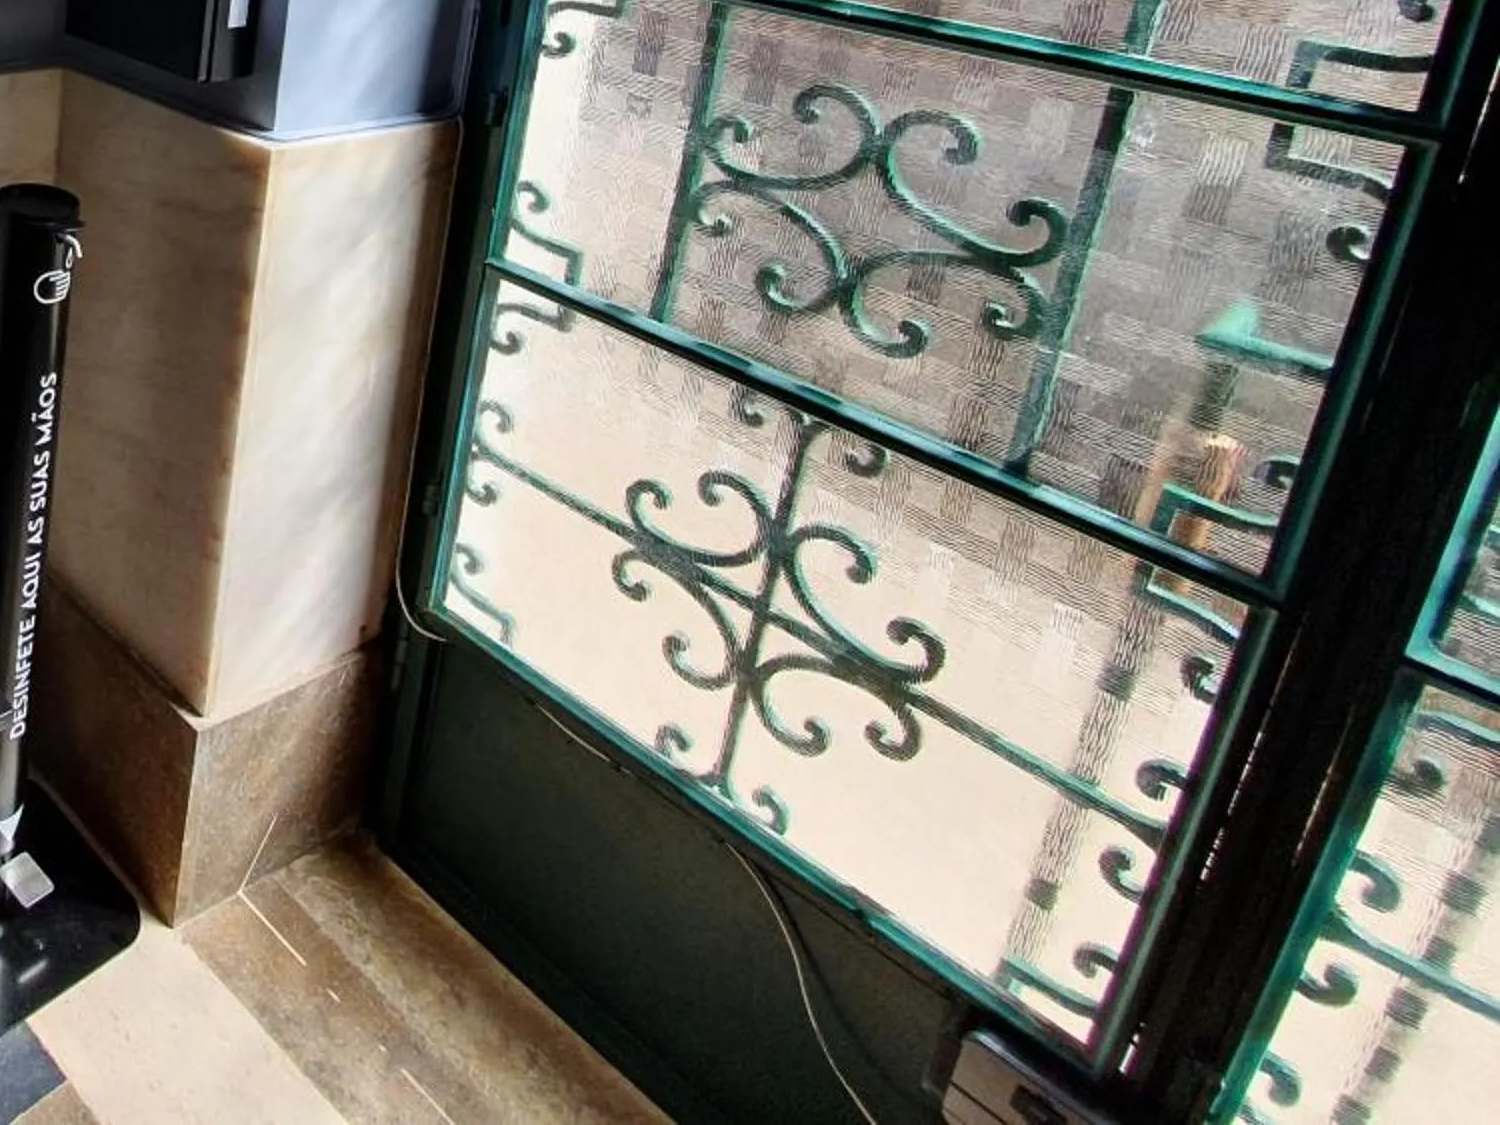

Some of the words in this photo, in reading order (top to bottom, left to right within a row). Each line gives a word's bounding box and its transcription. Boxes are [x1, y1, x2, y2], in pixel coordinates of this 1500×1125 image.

[31, 372, 58, 446] MÃOS
[29, 450, 51, 512] SUAS
[26, 516, 46, 544] AS
[20, 551, 42, 609] AQUI
[10, 614, 37, 740] DESINFETE
